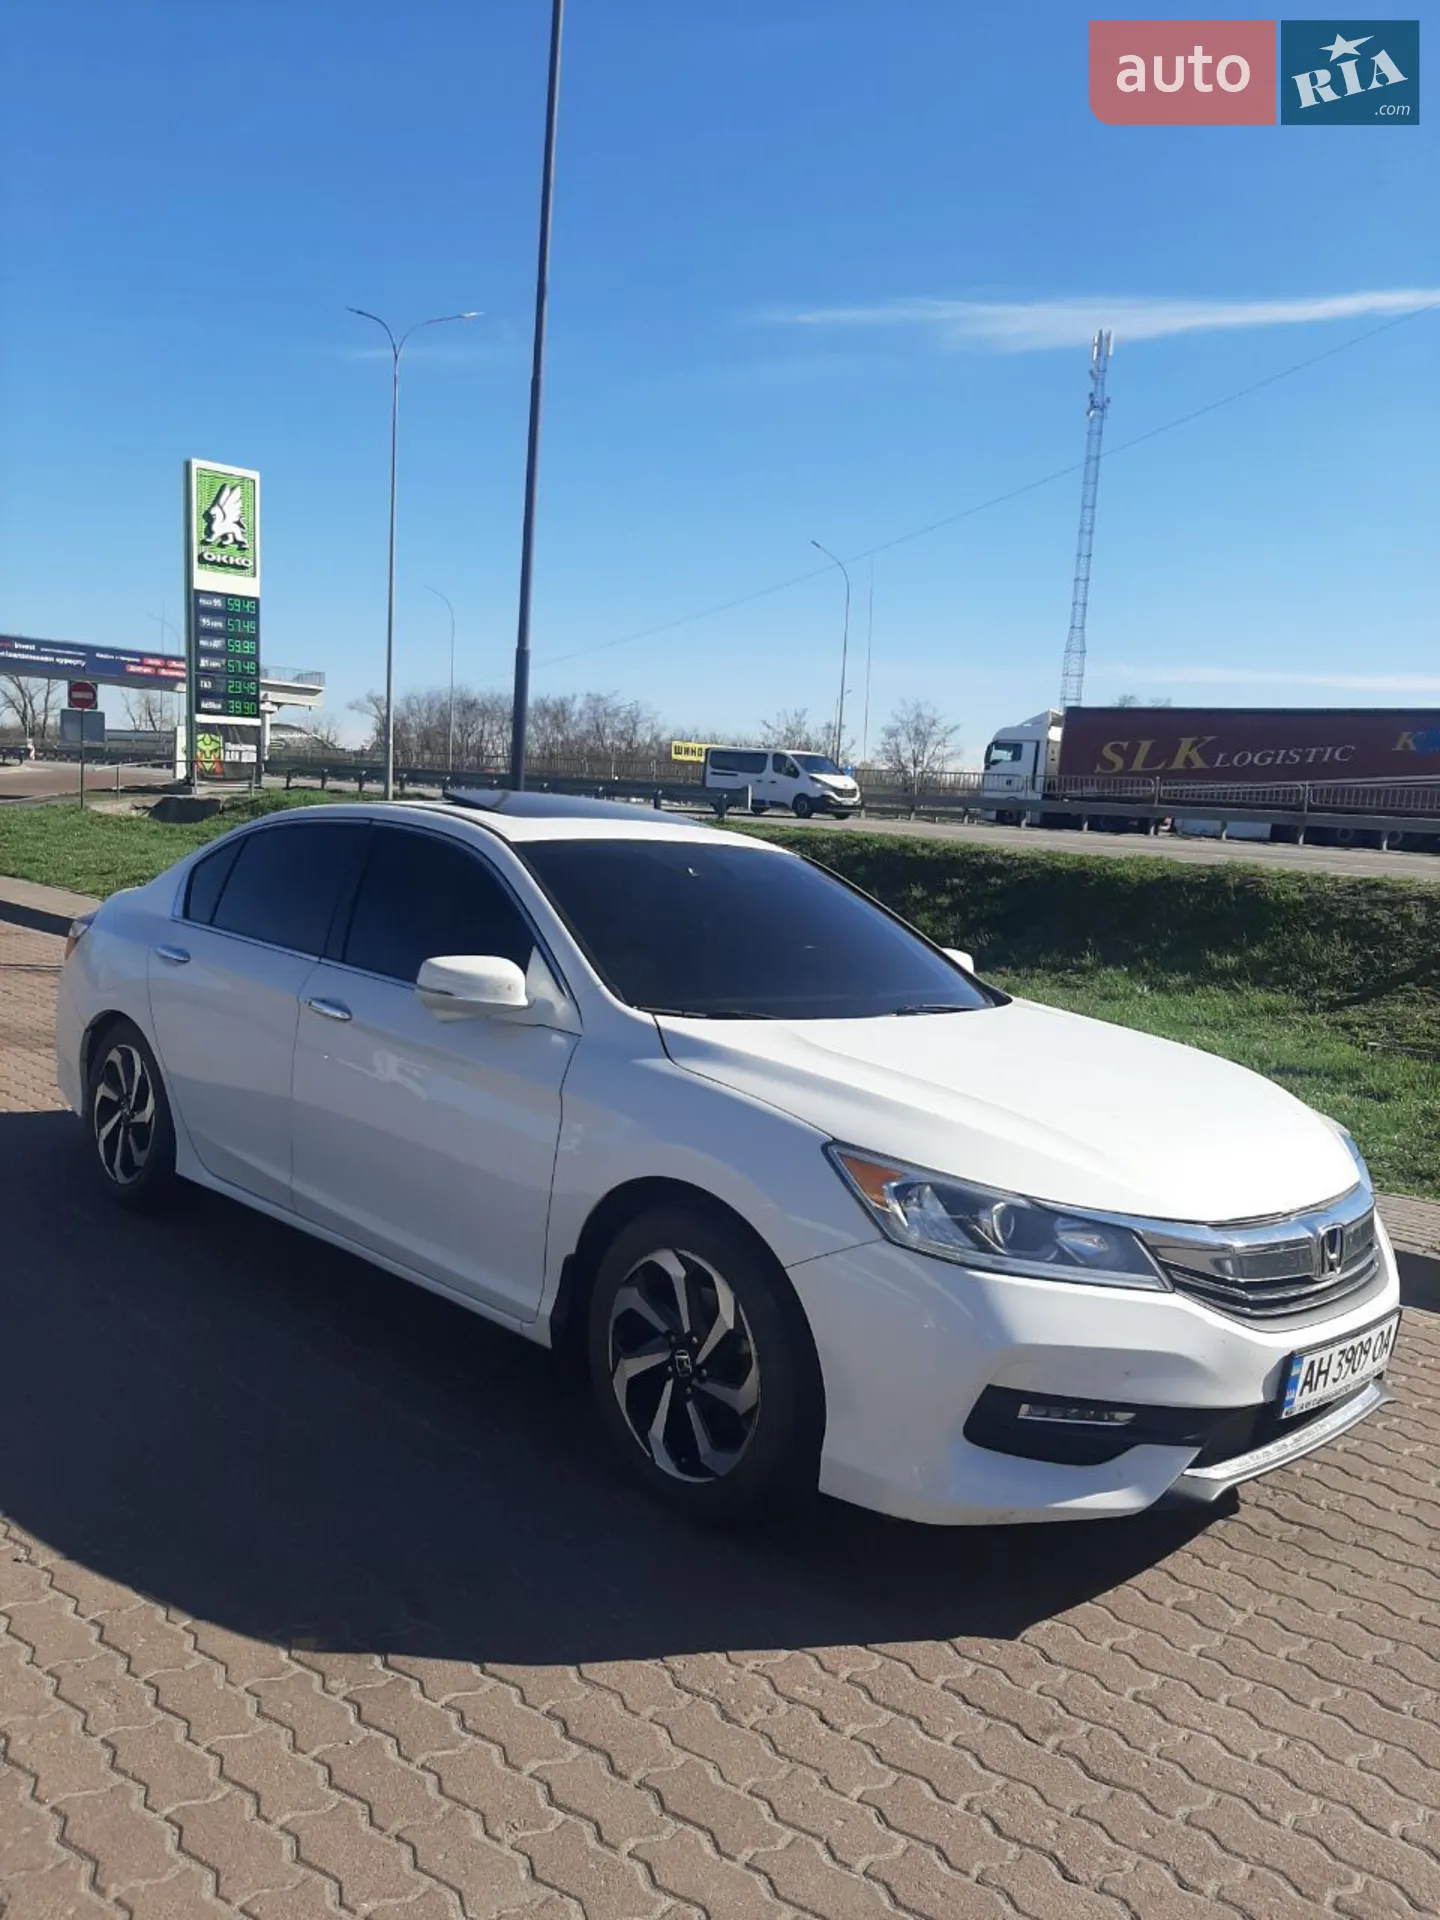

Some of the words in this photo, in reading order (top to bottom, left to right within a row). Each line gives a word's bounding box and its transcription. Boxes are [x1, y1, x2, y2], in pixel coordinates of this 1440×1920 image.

[203, 551, 253, 568] OKKO
[1093, 735, 1219, 774] SLK
[1212, 745, 1356, 768] LOGISTIC
[1299, 1353, 1333, 1397] AH
[1332, 1336, 1372, 1384] 3909
